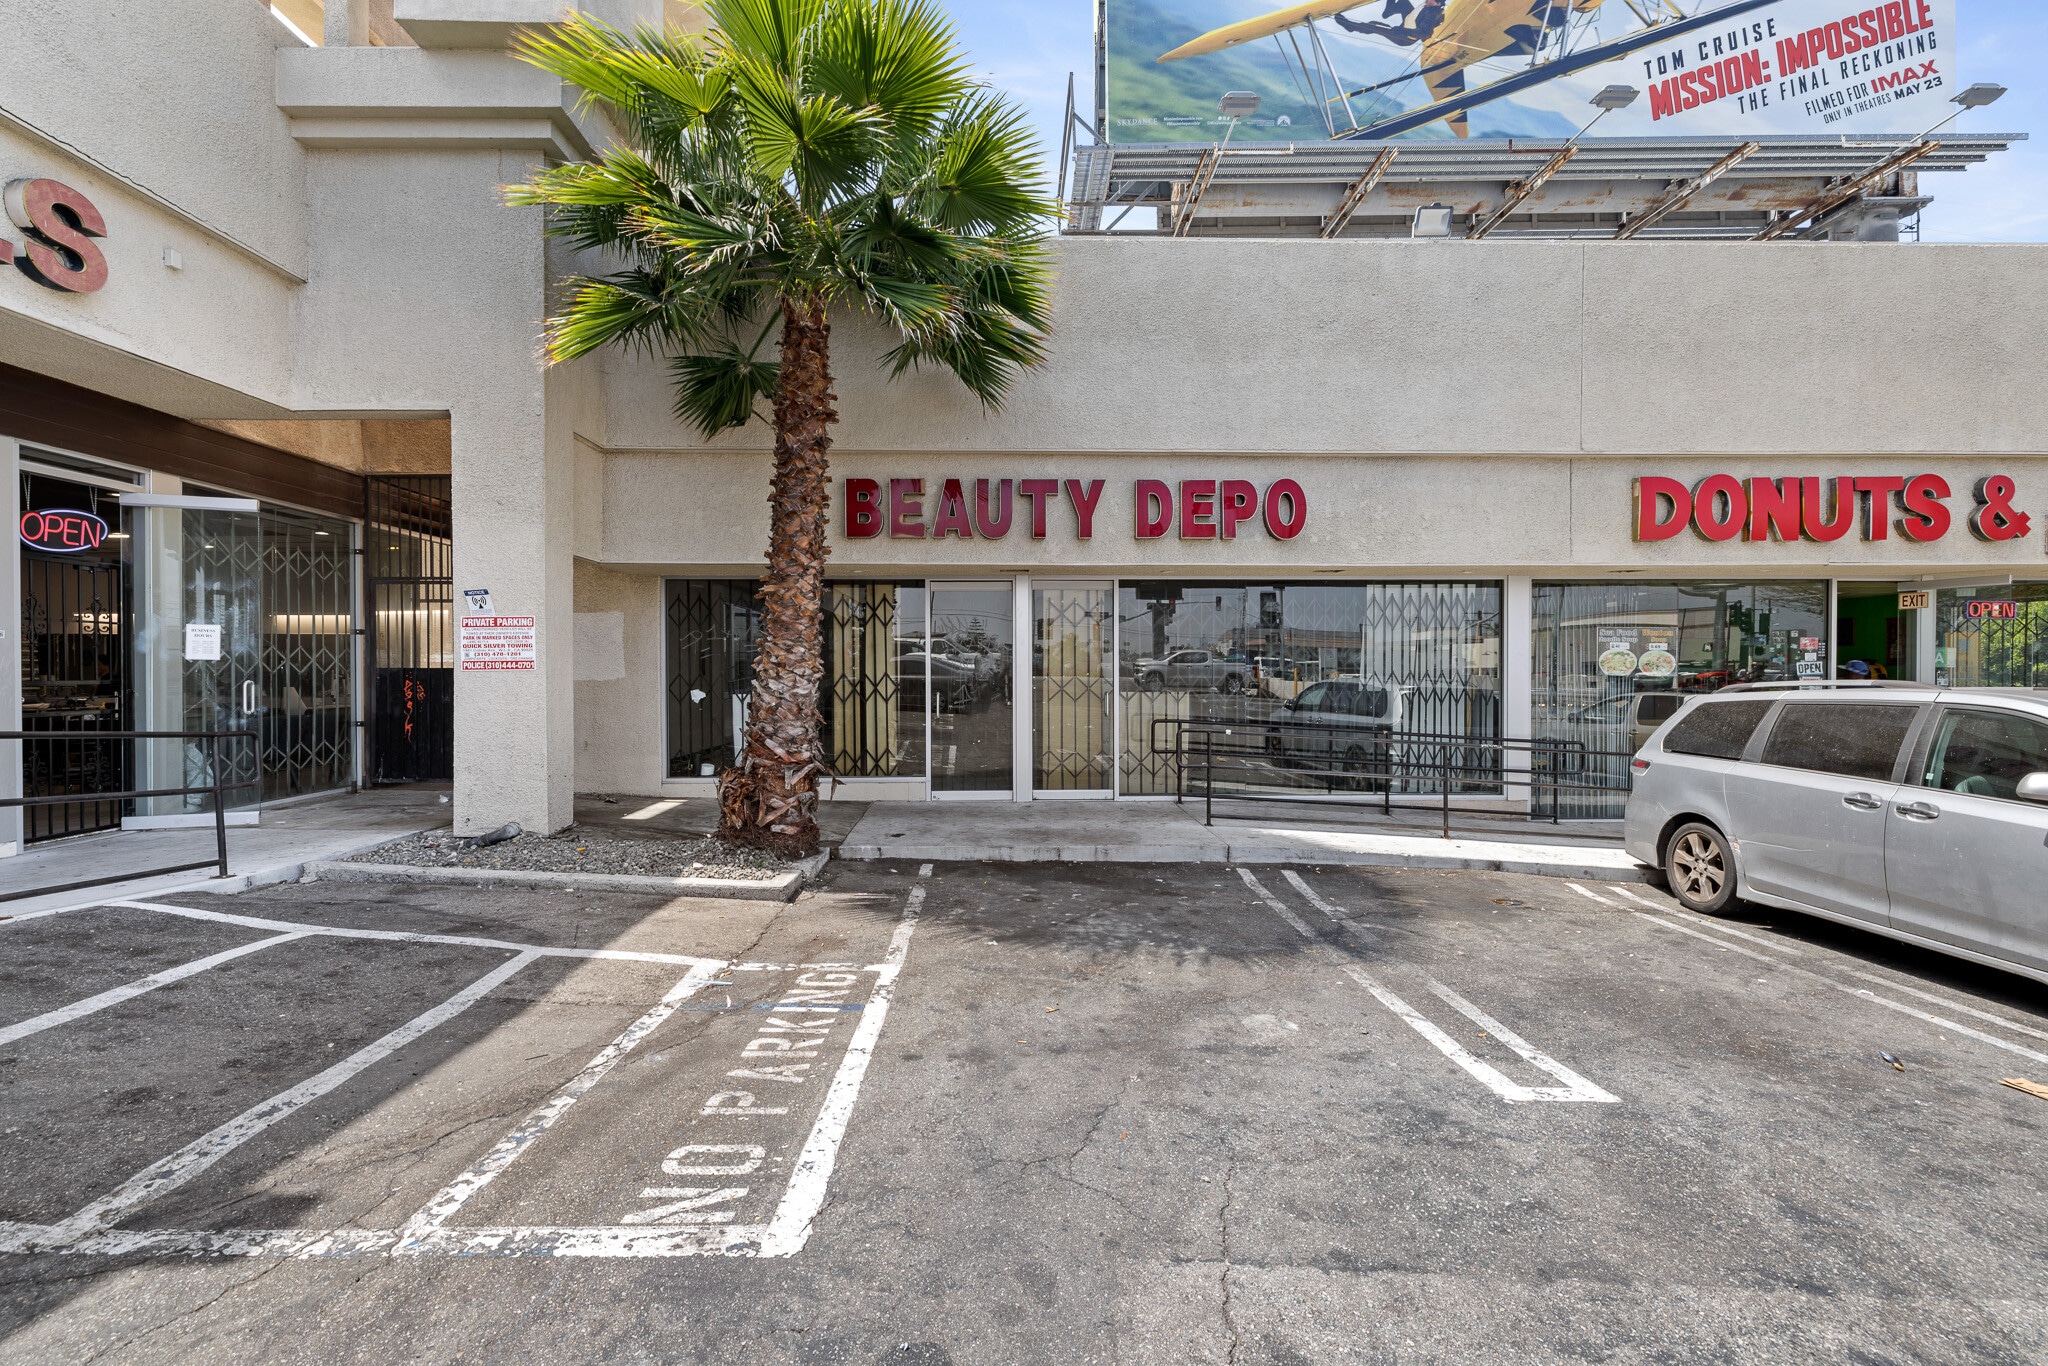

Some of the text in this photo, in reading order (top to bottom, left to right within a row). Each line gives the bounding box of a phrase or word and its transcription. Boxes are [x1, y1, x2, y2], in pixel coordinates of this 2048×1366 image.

[1643, 17, 1777, 80] TOM CRUISE
[1648, 0, 1934, 122] MISSION: IMPOSSIBLE
[1737, 31, 1937, 115] THE FINAL RECKONING
[1804, 59, 1940, 116] FILMED FOR IMAX
[1823, 75, 1943, 124] ONLY IN THEATRES MAY 23
[1117, 117, 1158, 126] SKYDANCE
[20, 511, 101, 548] OPEN
[844, 477, 1308, 541] BEAUTY DEPO
[1632, 472, 1952, 543] DONUTS
[1967, 474, 2032, 542] &
[463, 618, 533, 626] PRIVATE PARKING
[1901, 594, 1926, 607] EXIT
[1969, 602, 2015, 618] OPEN
[1797, 662, 1822, 674] OPEN
[1934, 652, 1945, 664] A
[619, 971, 858, 1225] NO PARKING
